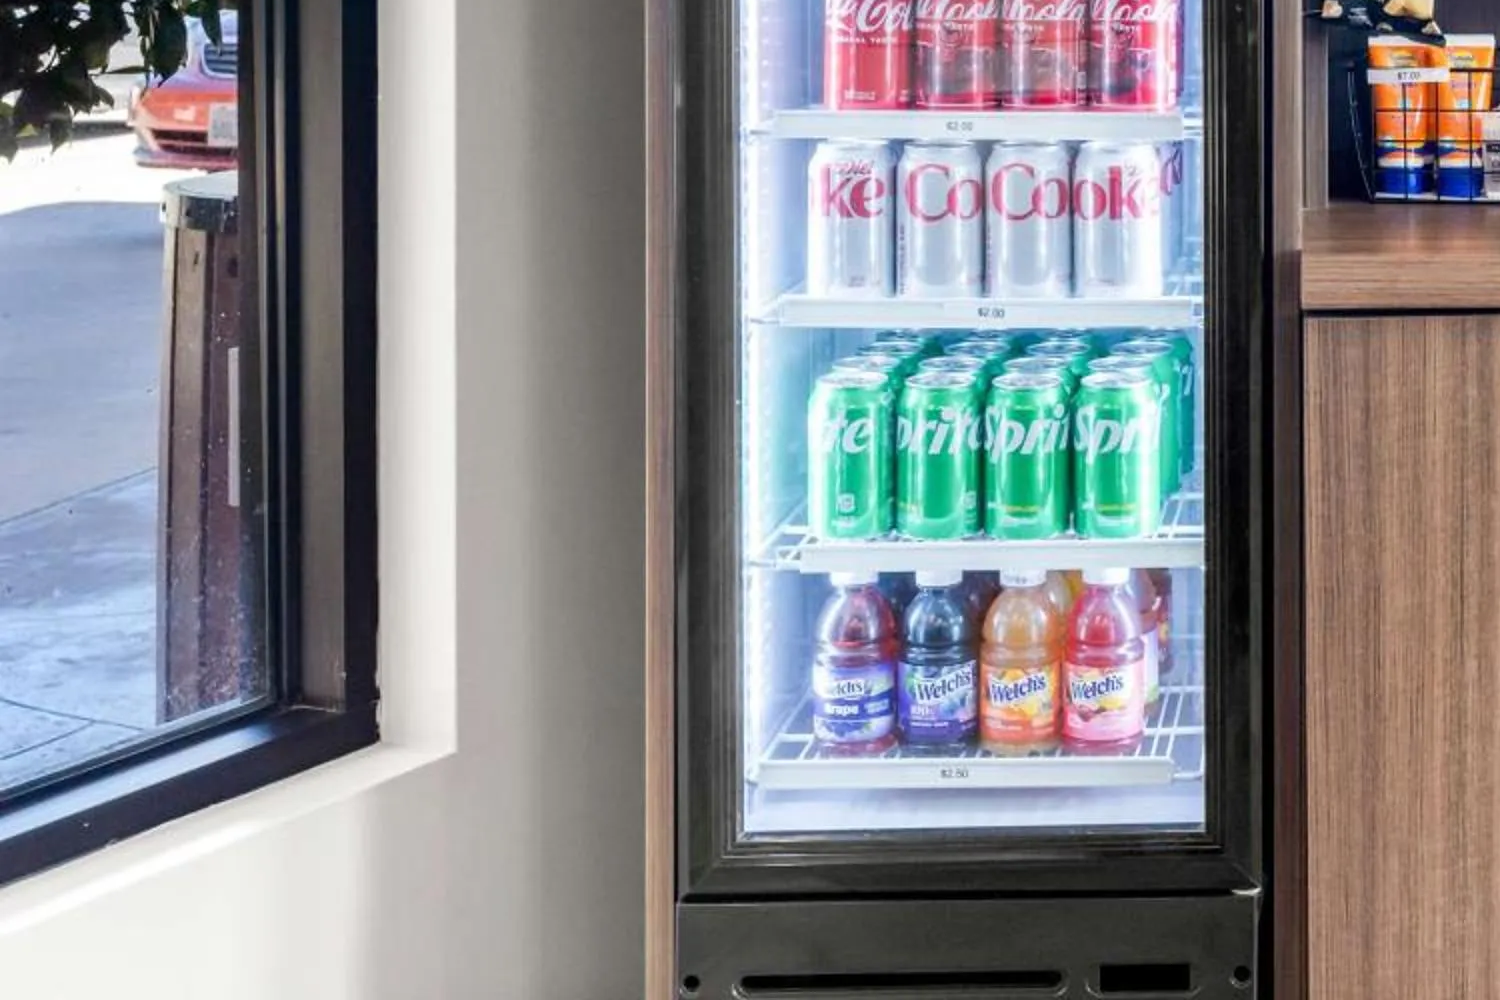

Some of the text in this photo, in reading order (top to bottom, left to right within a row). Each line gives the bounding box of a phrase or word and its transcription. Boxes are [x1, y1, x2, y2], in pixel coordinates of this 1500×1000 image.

[917, 666, 972, 702] Welch's
[990, 674, 1046, 702] Welch's
[1071, 675, 1124, 702] Welch's
